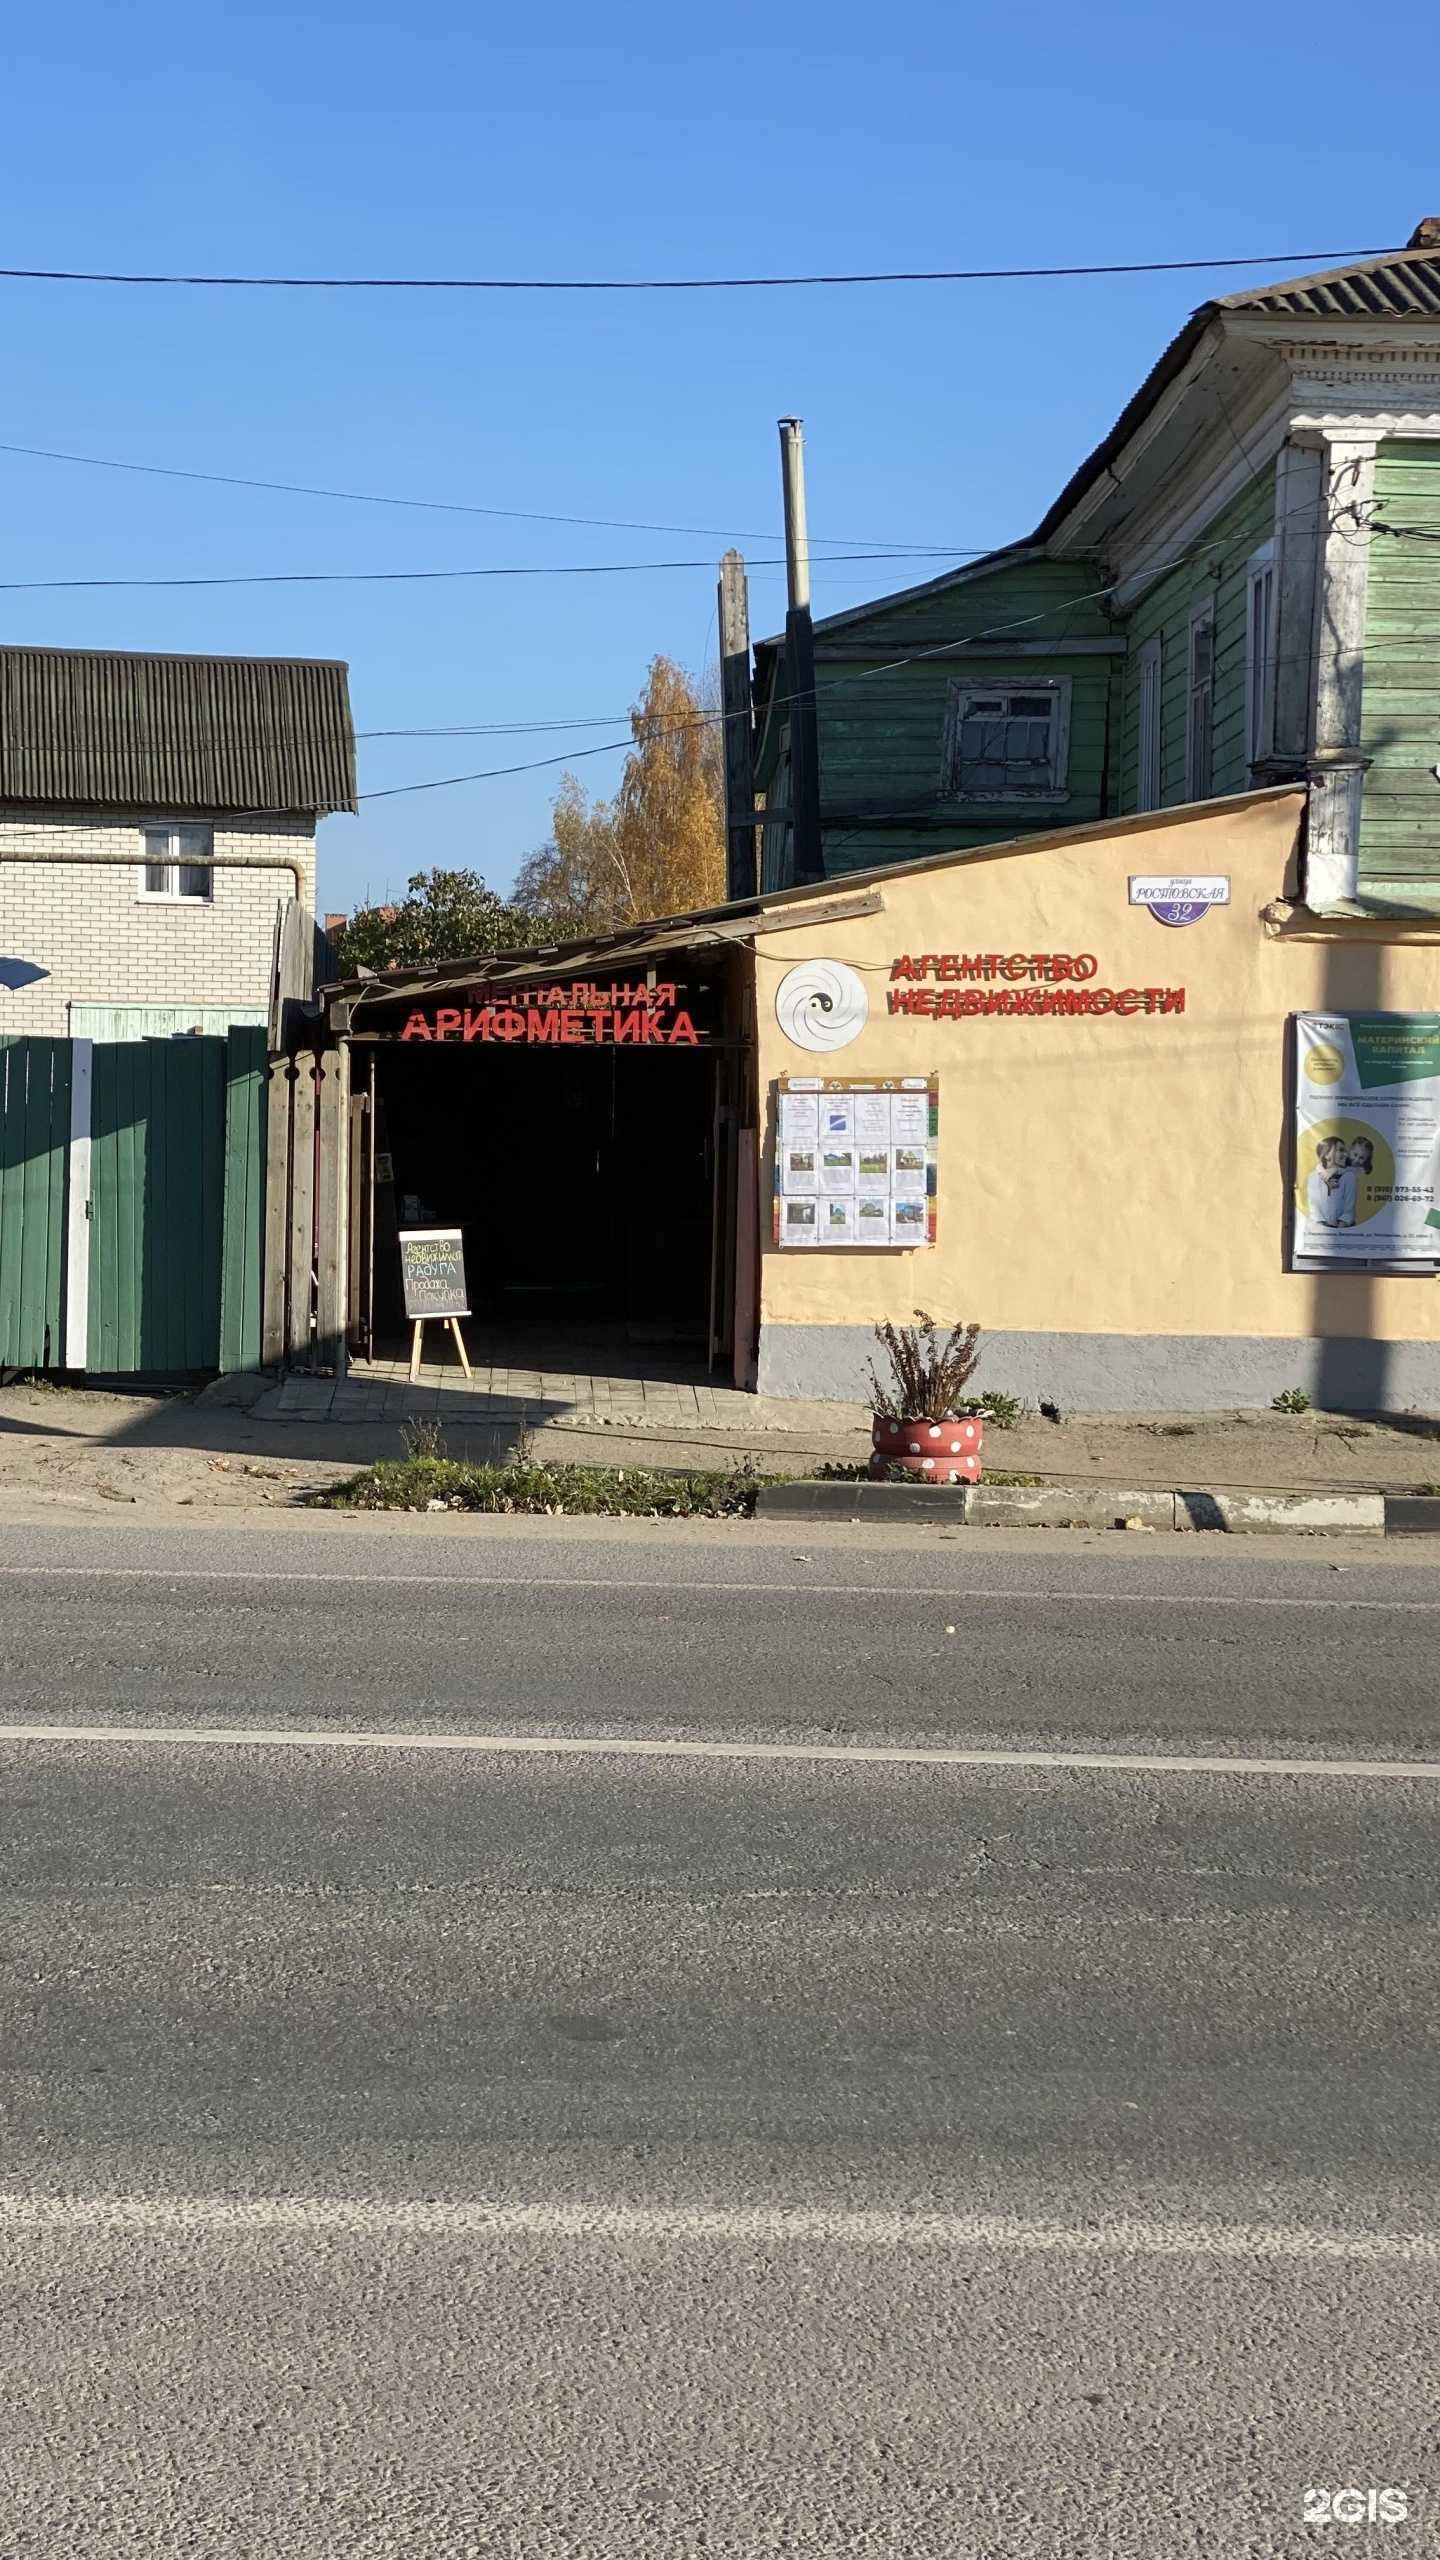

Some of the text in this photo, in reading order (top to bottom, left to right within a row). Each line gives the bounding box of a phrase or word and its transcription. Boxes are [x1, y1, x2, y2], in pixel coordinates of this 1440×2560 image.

[1136, 887, 1225, 899] РОСТОВСКАЯ
[1168, 902, 1193, 921] 32
[892, 953, 1098, 981] АГЕНТСТВО
[888, 987, 1186, 1019] НЕДВИЖИМОСТИ
[400, 1008, 699, 1044] АРИФМЕТИКА
